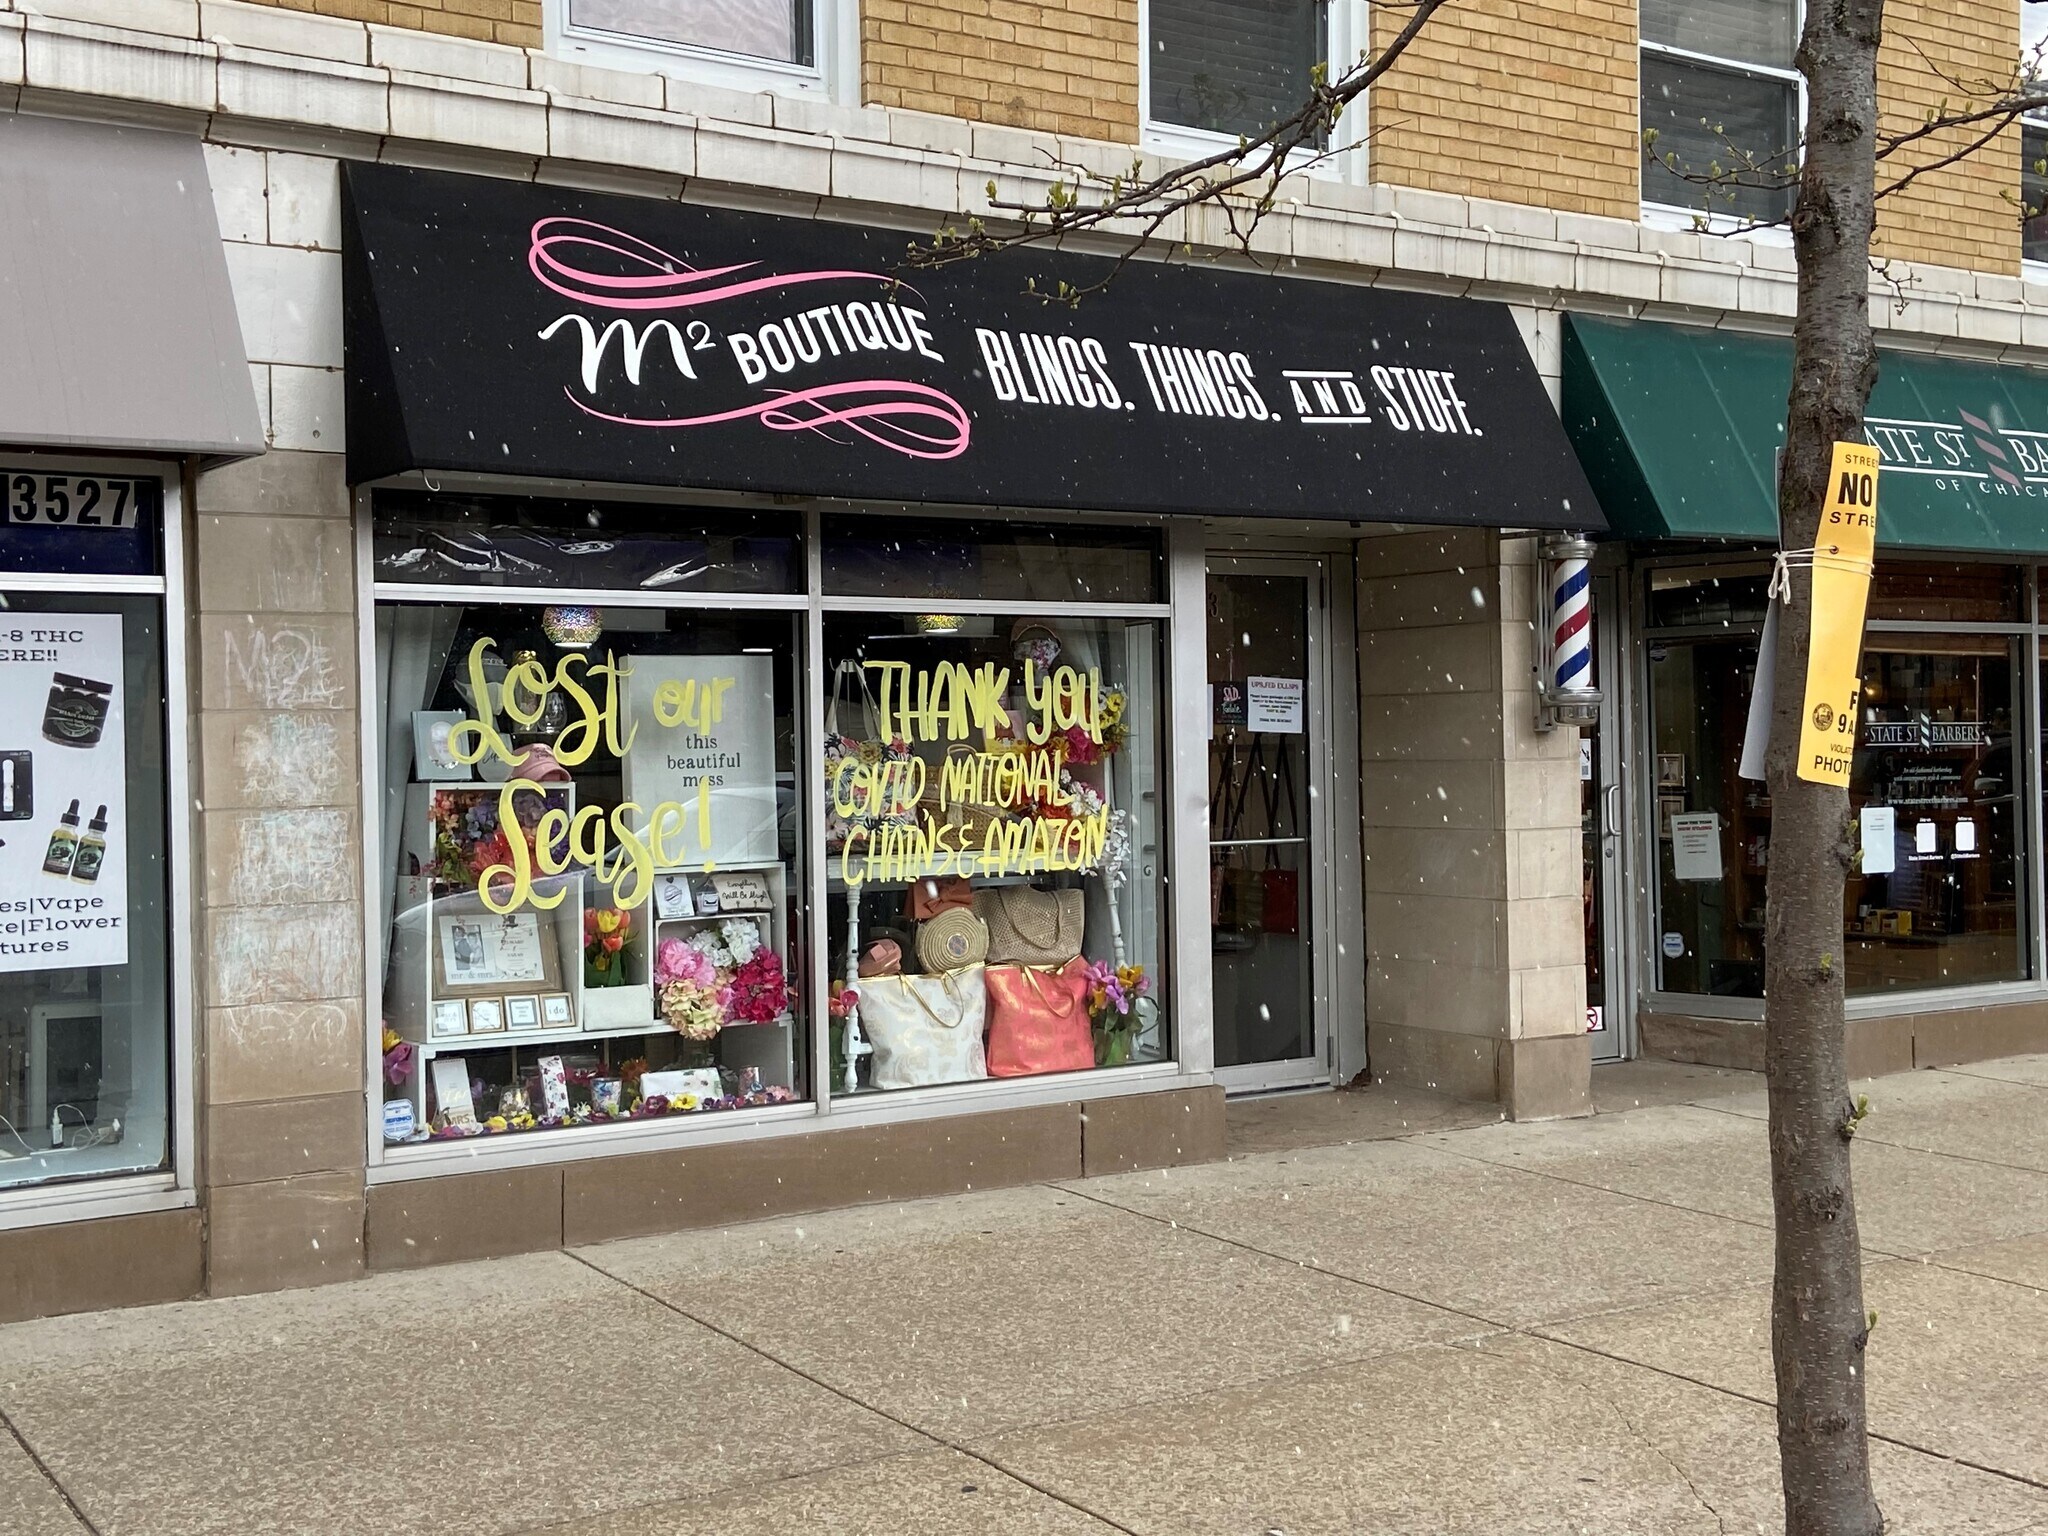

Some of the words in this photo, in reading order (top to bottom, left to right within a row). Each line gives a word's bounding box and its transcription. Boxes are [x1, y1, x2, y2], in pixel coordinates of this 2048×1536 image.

[727, 301, 945, 385] BOUTIQUE
[974, 328, 1135, 411] BLINGS.
[1128, 341, 1282, 421] THINGS.
[1289, 380, 1367, 415] AND
[1370, 365, 1484, 436] STUFF.
[1845, 454, 1878, 469] STREE
[12, 475, 134, 526] 3527
[1838, 472, 1873, 507] NO
[1935, 478, 1960, 492] OF
[31, 630, 83, 642] THC
[448, 636, 639, 767] Lost
[652, 676, 737, 736] our
[862, 660, 1011, 745] THANK
[1837, 713, 1848, 733] 9
[686, 733, 718, 749] this
[1870, 725, 1903, 742] STATE
[1932, 725, 1980, 742] BARBERS
[667, 752, 741, 769] beautiful
[833, 755, 926, 818] COVID
[940, 749, 1078, 813] NATIONAL
[478, 775, 717, 914] Lease!
[977, 804, 1108, 878] AMAZON
